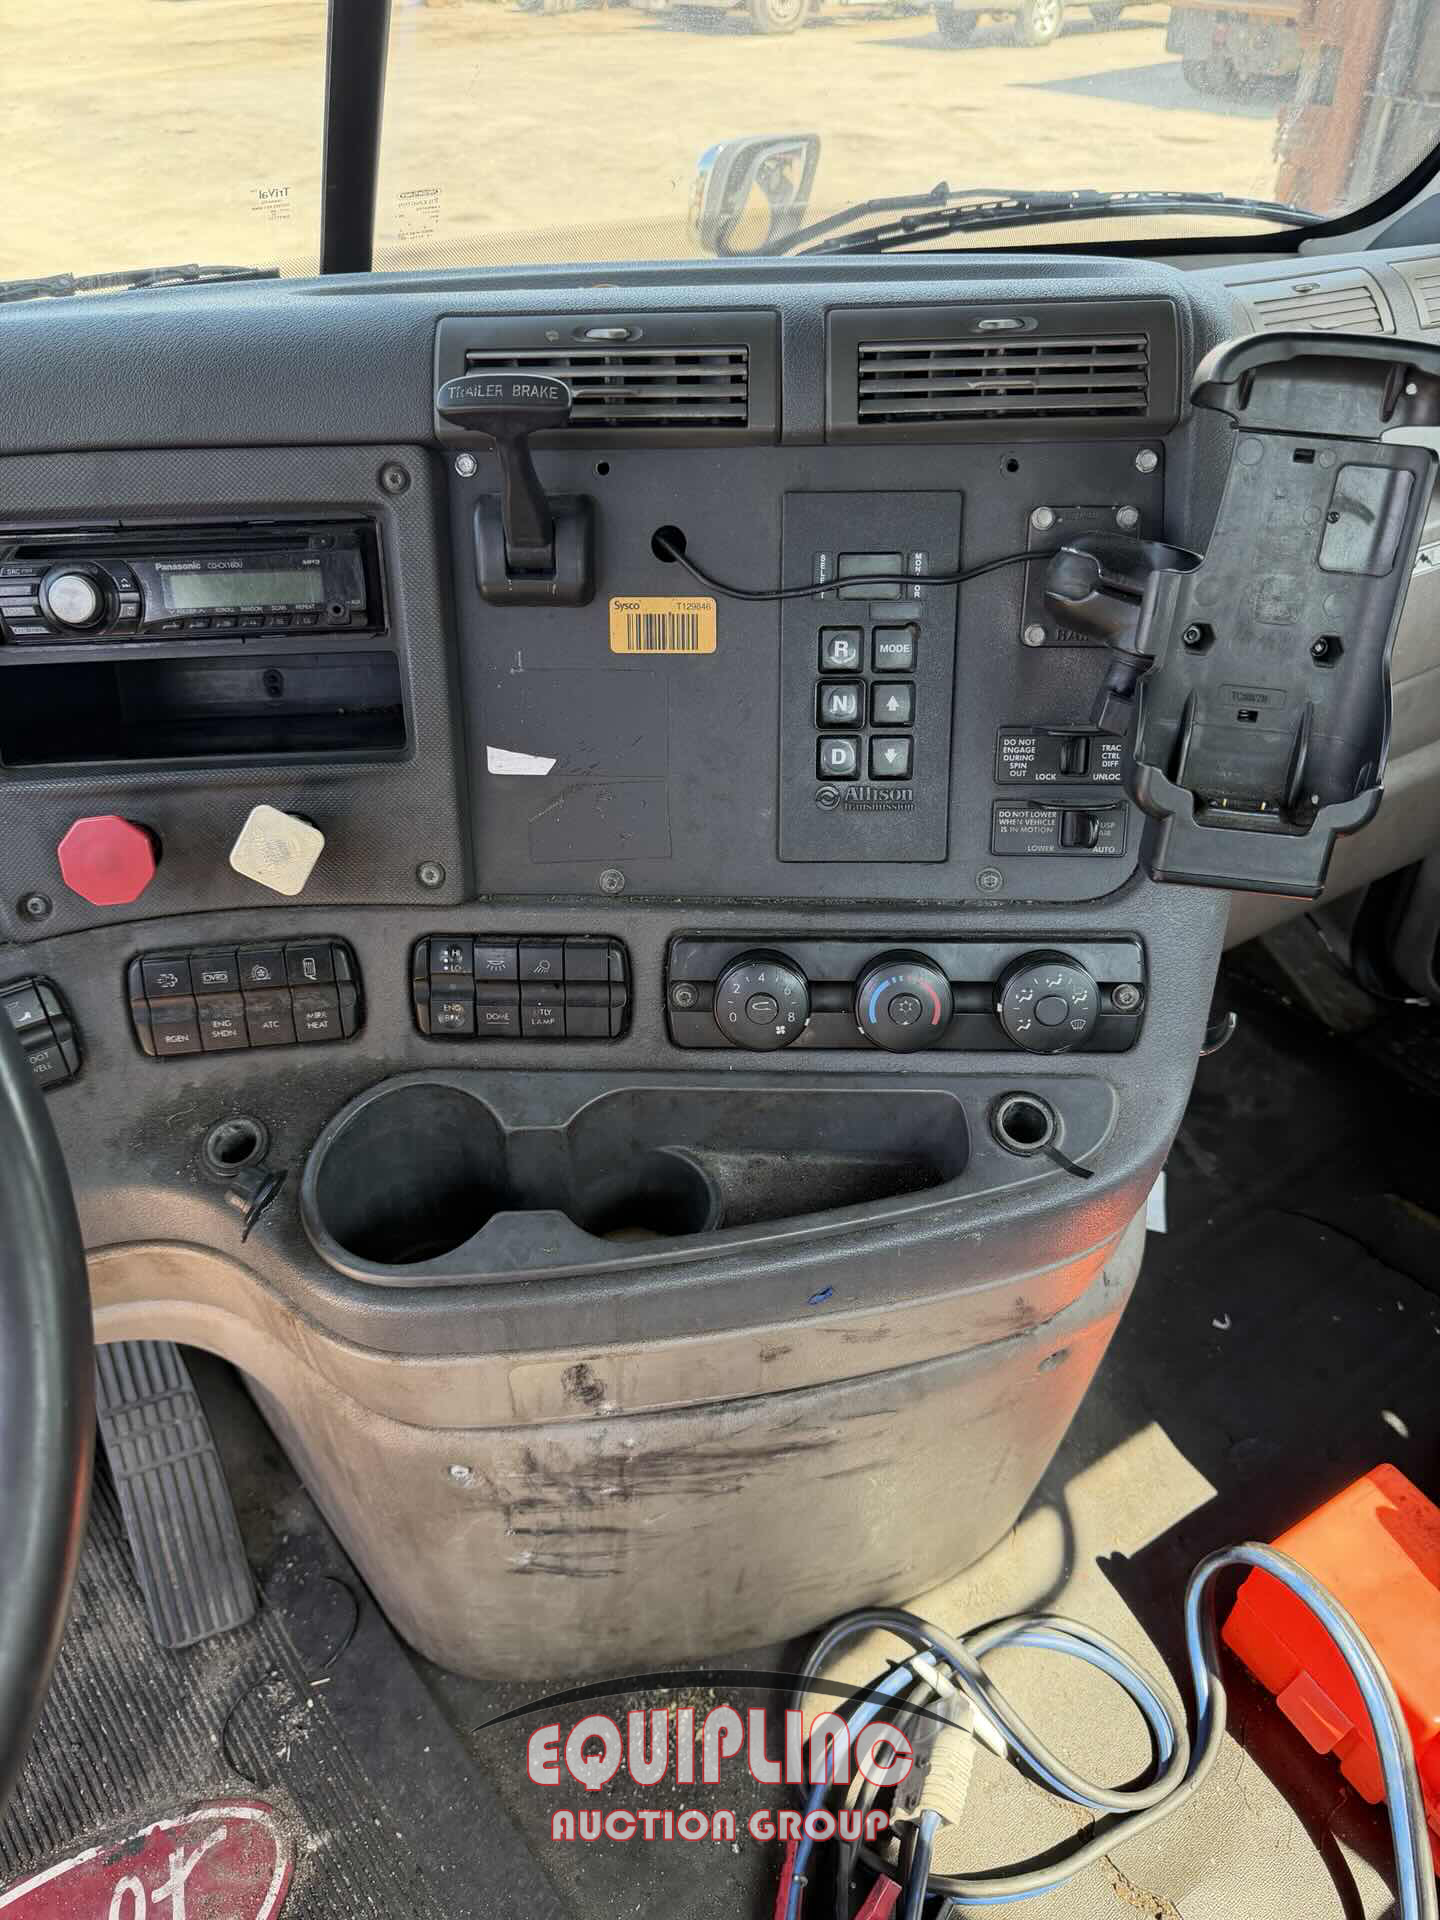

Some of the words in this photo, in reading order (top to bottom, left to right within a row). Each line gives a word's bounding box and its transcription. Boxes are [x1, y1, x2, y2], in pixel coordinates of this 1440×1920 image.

[448, 385, 503, 399] TRAILER
[512, 384, 559, 399] BRAKE
[155, 562, 201, 571] Panasonic
[914, 553, 922, 598] MONOR
[614, 600, 640, 612] Sysco
[834, 641, 848, 656] R
[880, 644, 911, 653] MODE
[833, 695, 848, 711] N
[831, 749, 846, 765] D
[845, 786, 913, 801] Allison
[758, 973, 765, 982] 4
[734, 983, 741, 993] 2
[784, 986, 791, 996] 6
[486, 1012, 510, 1020] DOME
[729, 1012, 737, 1022] 0
[788, 1012, 795, 1022] 8
[212, 1020, 232, 1028] ENG
[262, 1020, 280, 1029] ATC
[307, 1020, 329, 1029] HEAT
